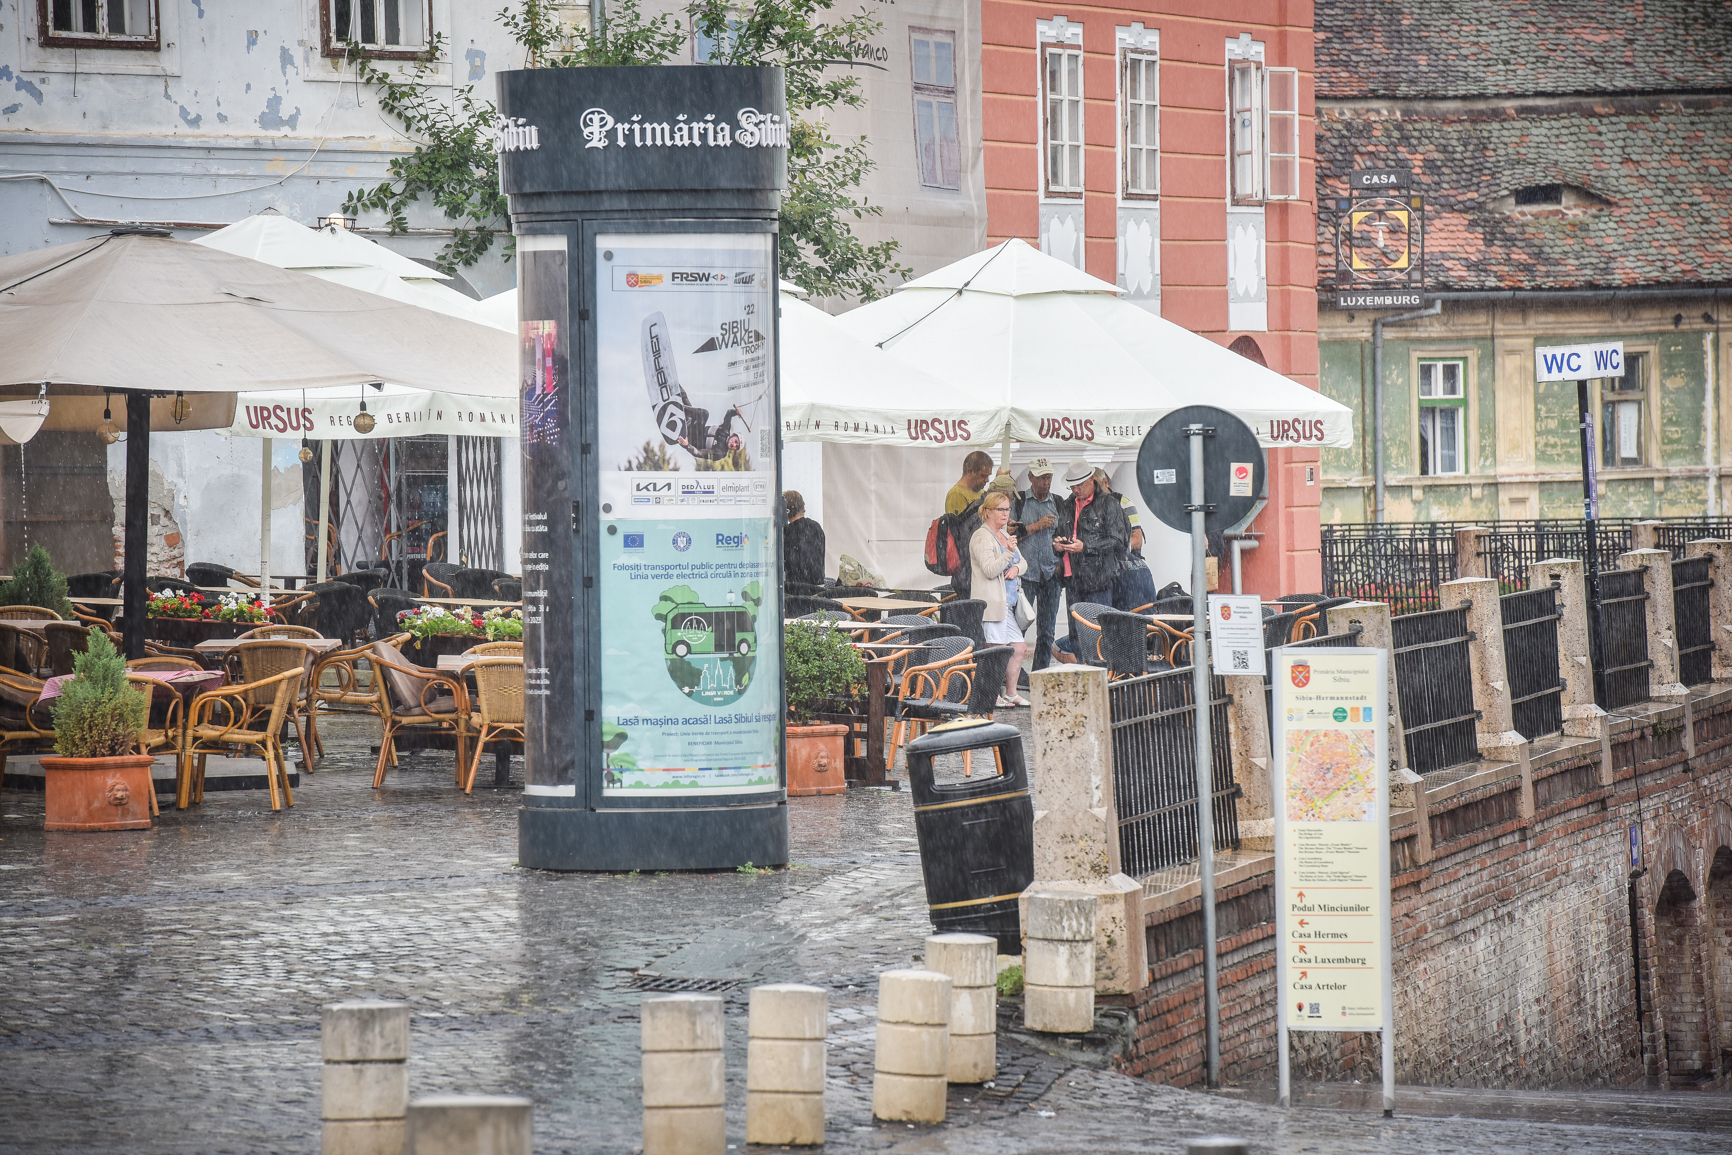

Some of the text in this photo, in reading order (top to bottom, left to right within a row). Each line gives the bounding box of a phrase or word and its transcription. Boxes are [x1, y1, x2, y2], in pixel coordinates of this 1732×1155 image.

[580, 107, 733, 150] Primăria
[1362, 174, 1397, 186] CASA
[672, 272, 710, 282] FRSW
[1340, 294, 1420, 307] LUXEMBURG
[720, 318, 750, 336] SIBIU
[716, 330, 754, 350] WAKE
[1542, 352, 1582, 374] WC
[1594, 348, 1620, 371] WC
[246, 404, 314, 433] URSUS
[330, 415, 377, 426] REGE
[458, 411, 516, 425] ROMÂNI
[907, 418, 970, 443] URSUS
[1038, 417, 1094, 441] URSUS
[1106, 426, 1142, 436] REGELE
[1270, 418, 1324, 442] URSUS
[636, 482, 672, 492] KIA
[722, 483, 750, 494] elmiplant
[613, 563, 641, 573] Folosiți
[644, 563, 689, 572] transportul
[691, 562, 714, 571] public
[715, 562, 738, 570] pentru
[676, 571, 708, 579] electrică
[617, 715, 639, 726] Lasă
[642, 716, 679, 728] mașina
[682, 715, 712, 726] acasă!
[714, 714, 732, 725] Lasă
[734, 713, 754, 724] Sibiul
[1291, 904, 1370, 912] Podul Minciunilor
[1291, 930, 1348, 939] Casa Hermes
[1292, 956, 1366, 966] Casa Luxemburg
[1293, 982, 1347, 990] Casa Artelor
